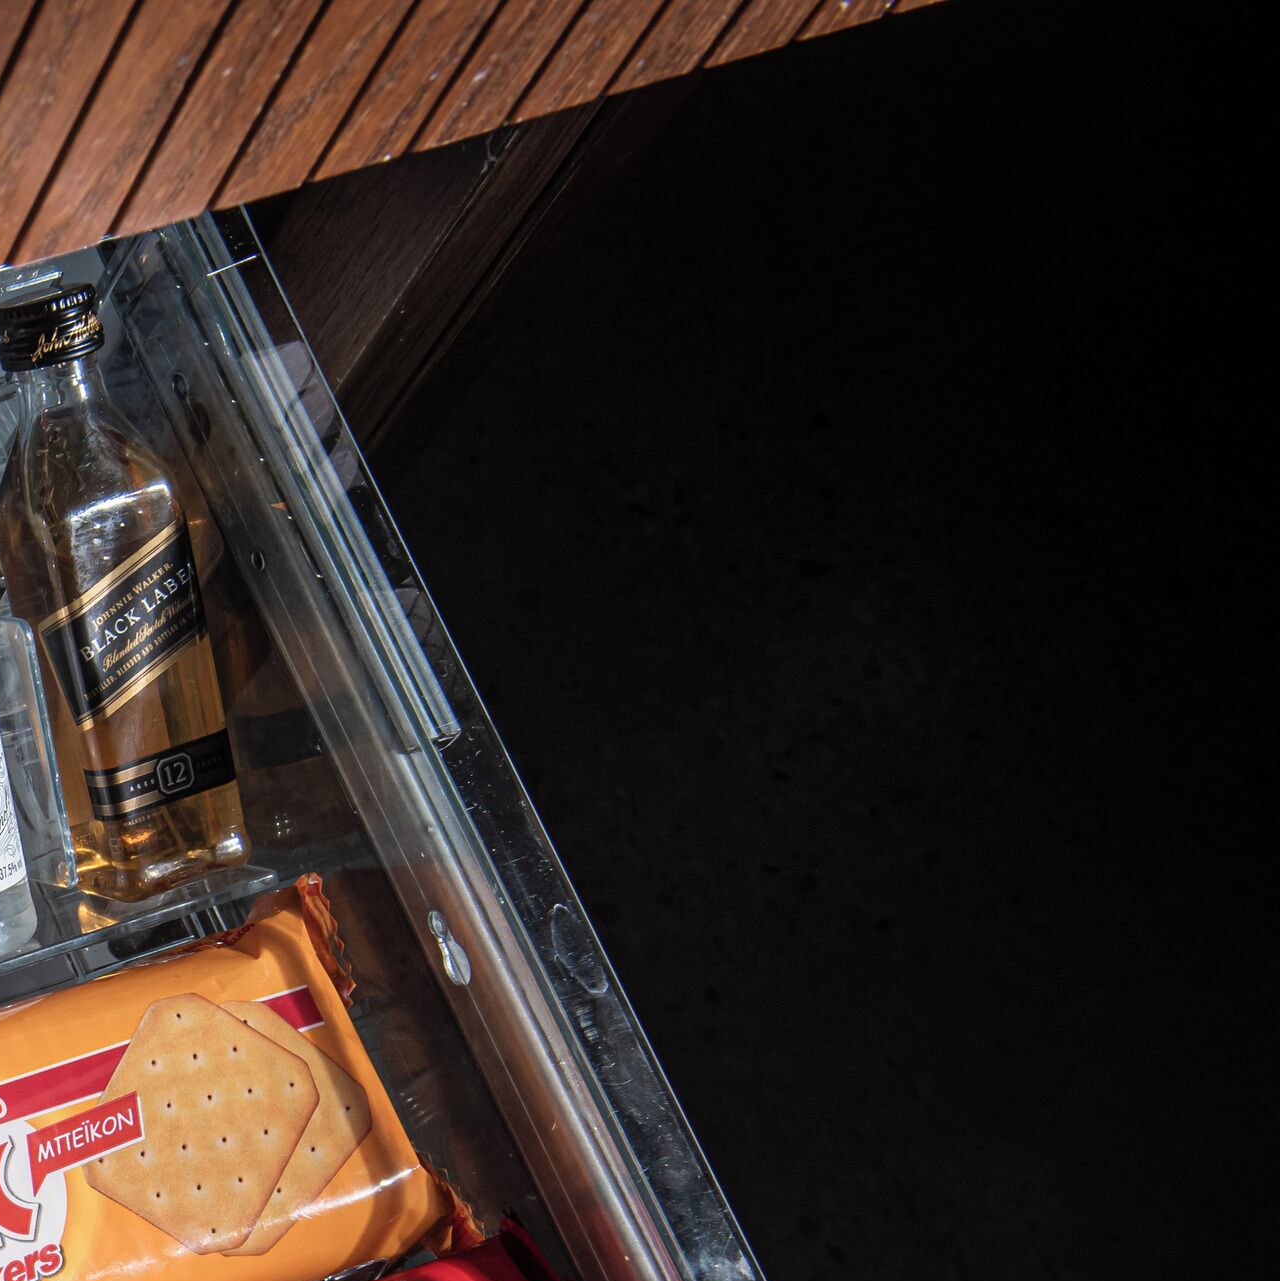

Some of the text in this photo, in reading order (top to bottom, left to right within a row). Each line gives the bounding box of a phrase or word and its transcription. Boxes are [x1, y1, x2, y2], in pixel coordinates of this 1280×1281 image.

[80, 607, 140, 661] BLACK
[92, 594, 133, 631] JOHNNIE
[129, 763, 187, 792] AGED 12
[37, 1108, 136, 1164] ΜΠΕΪΚΟΝ
